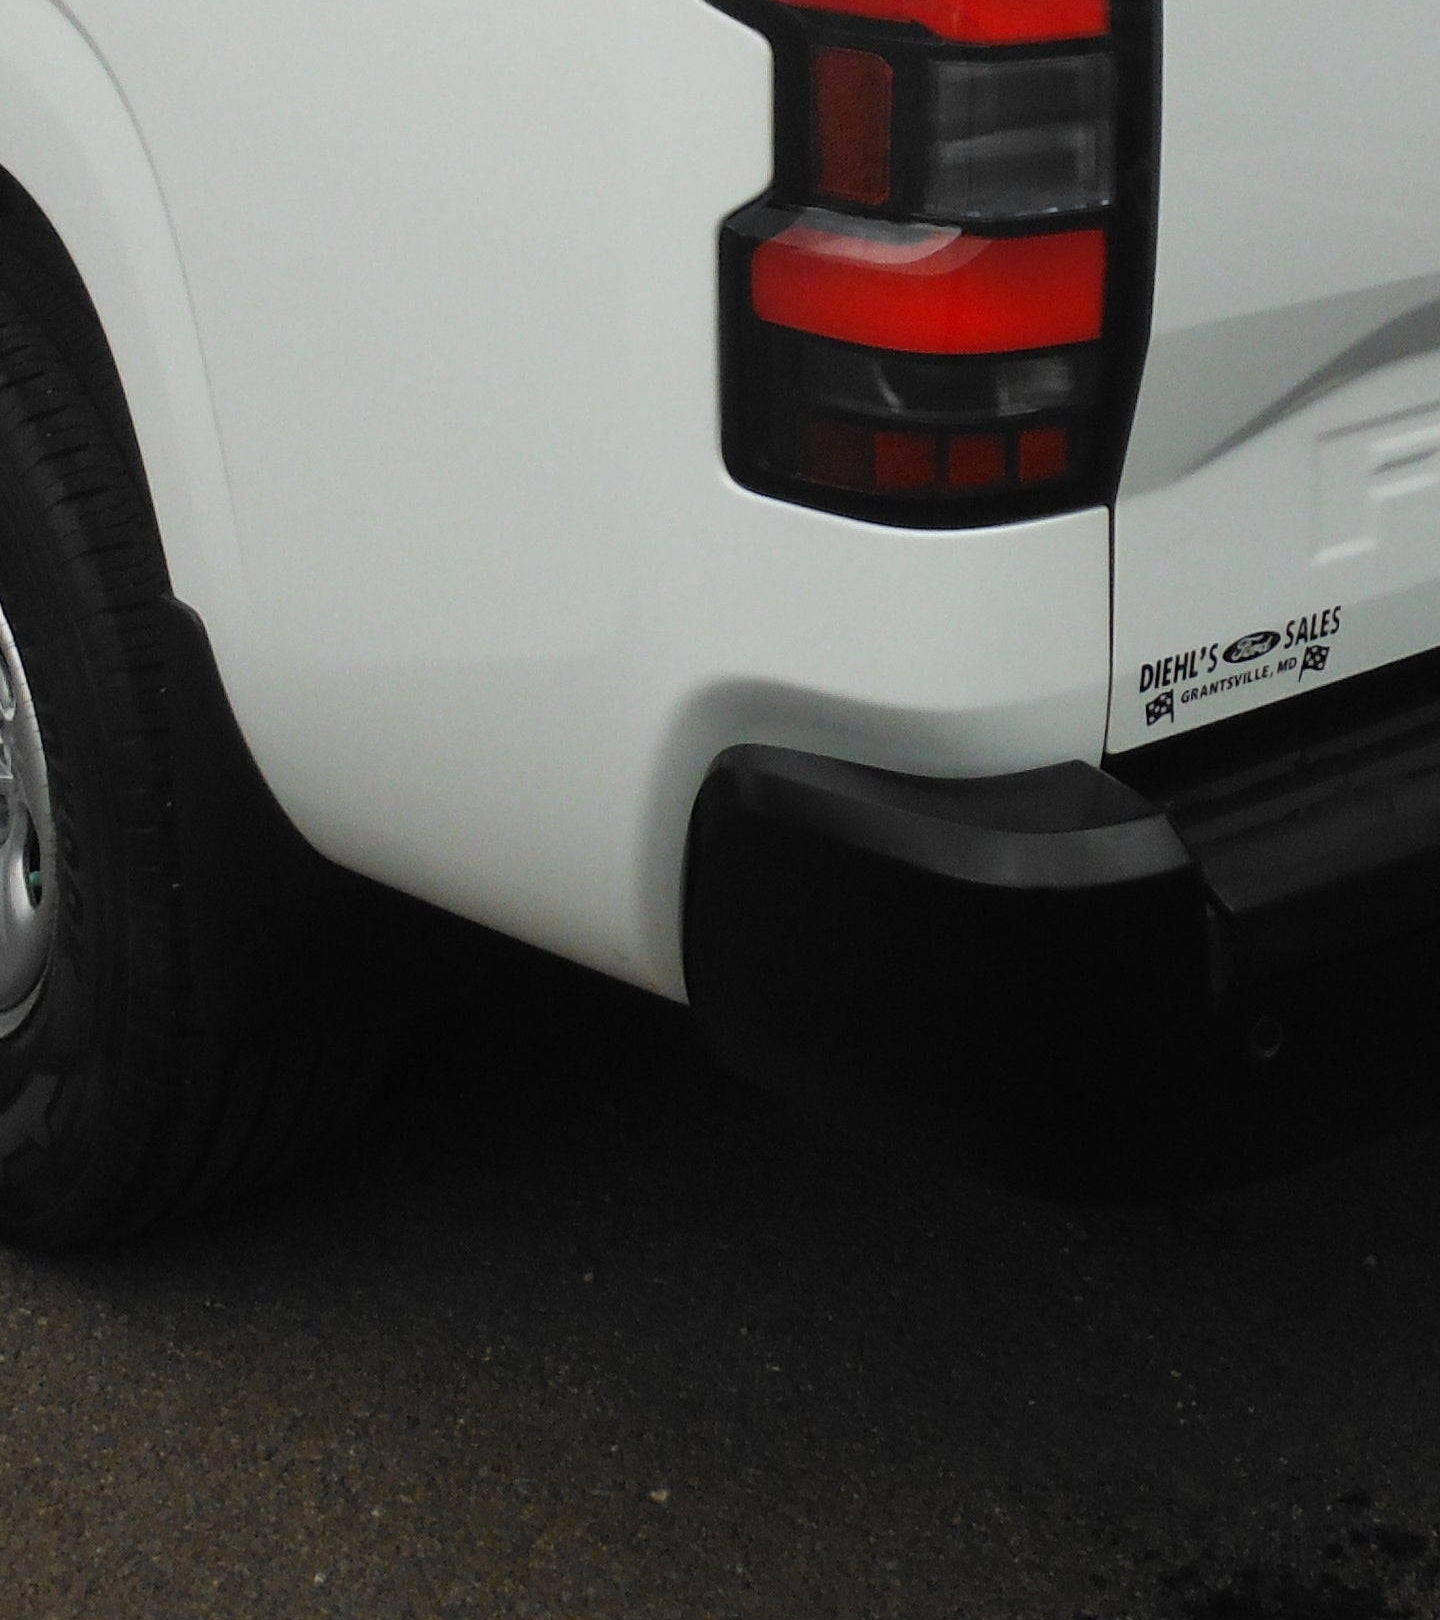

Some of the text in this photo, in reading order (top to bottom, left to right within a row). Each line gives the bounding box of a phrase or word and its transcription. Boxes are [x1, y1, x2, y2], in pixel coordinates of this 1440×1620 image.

[1139, 605, 1342, 693] DIEHL'S Ford SALES
[1180, 657, 1298, 704] GRANTSVILLE, MD
